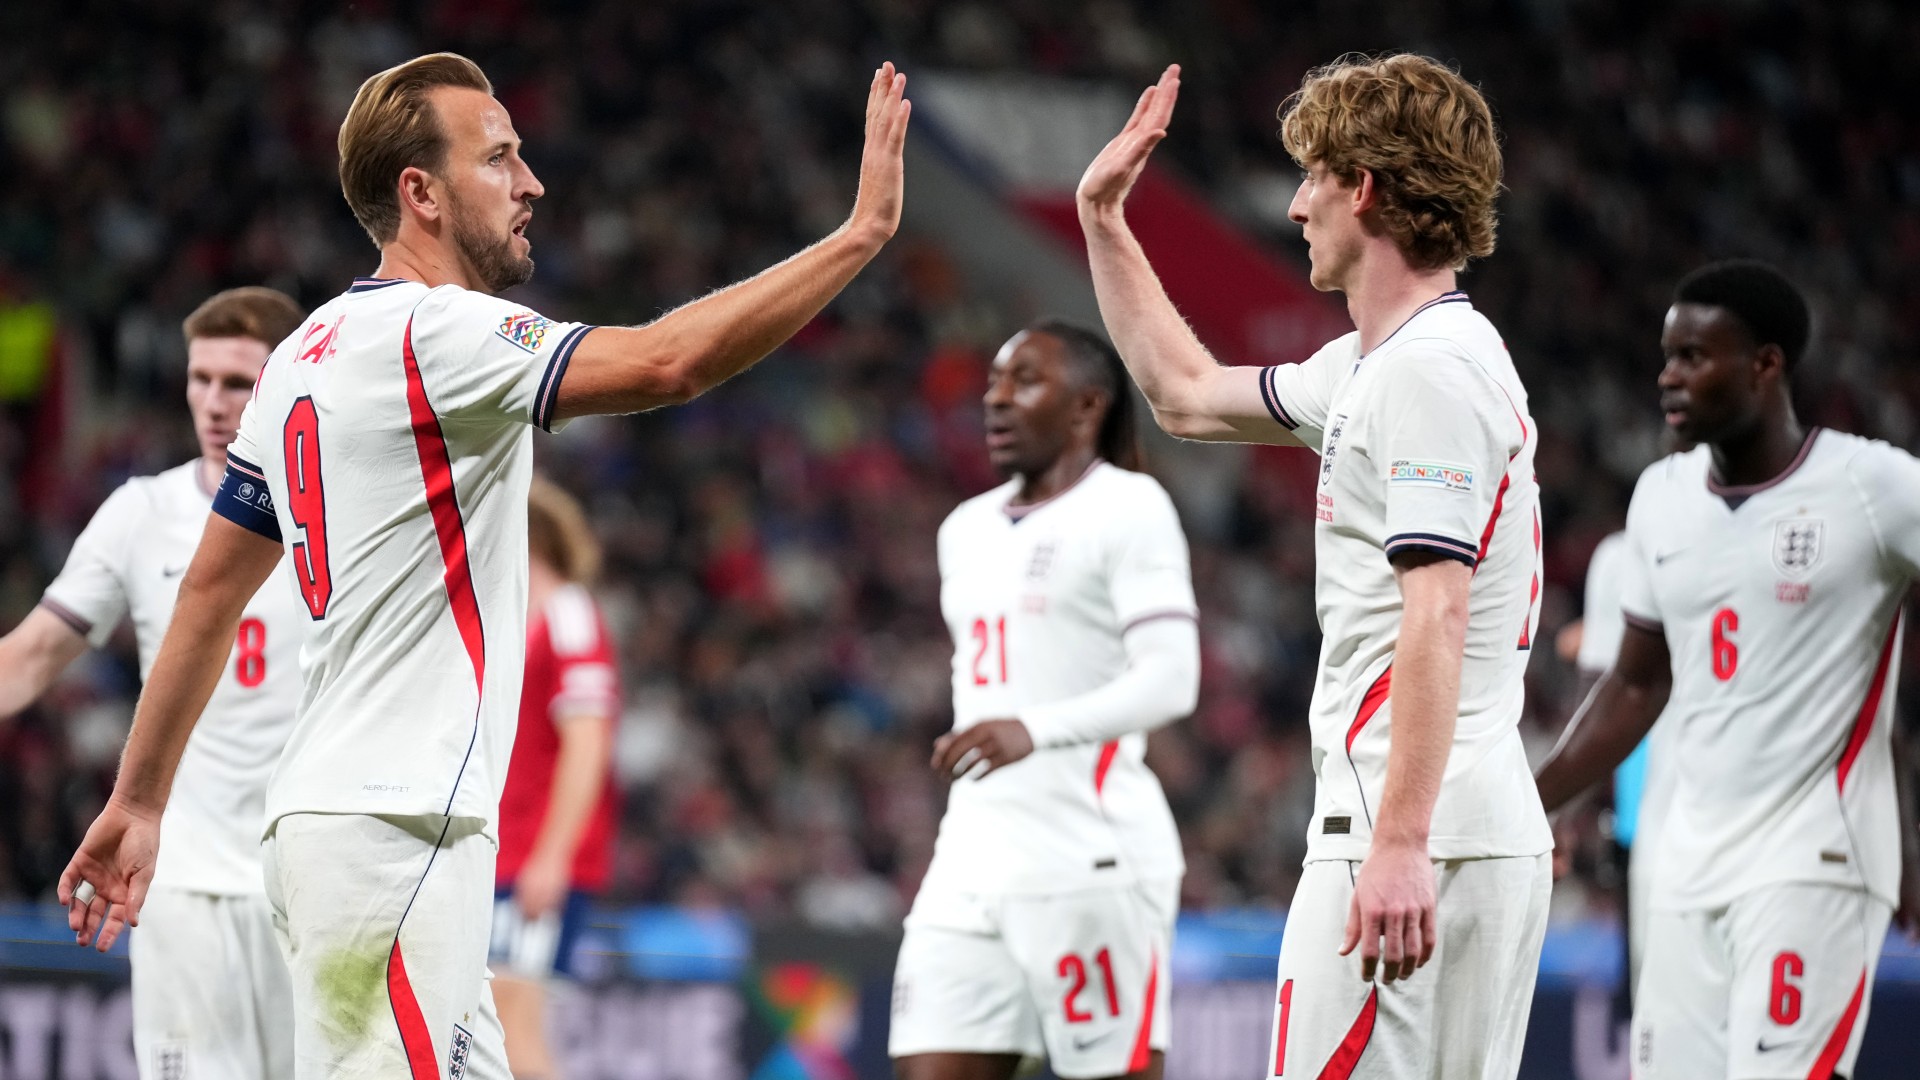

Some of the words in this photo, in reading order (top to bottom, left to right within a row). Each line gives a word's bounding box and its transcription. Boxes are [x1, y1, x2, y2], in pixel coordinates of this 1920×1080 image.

[283, 394, 333, 622] 9
[1391, 467, 1473, 485] FOUNDATION
[233, 617, 267, 690] 8
[972, 613, 1009, 687] 21
[1710, 606, 1740, 683] 6
[362, 784, 411, 793] AERO-FIT
[1056, 946, 1121, 1025] 21
[1767, 950, 1805, 1027] 6
